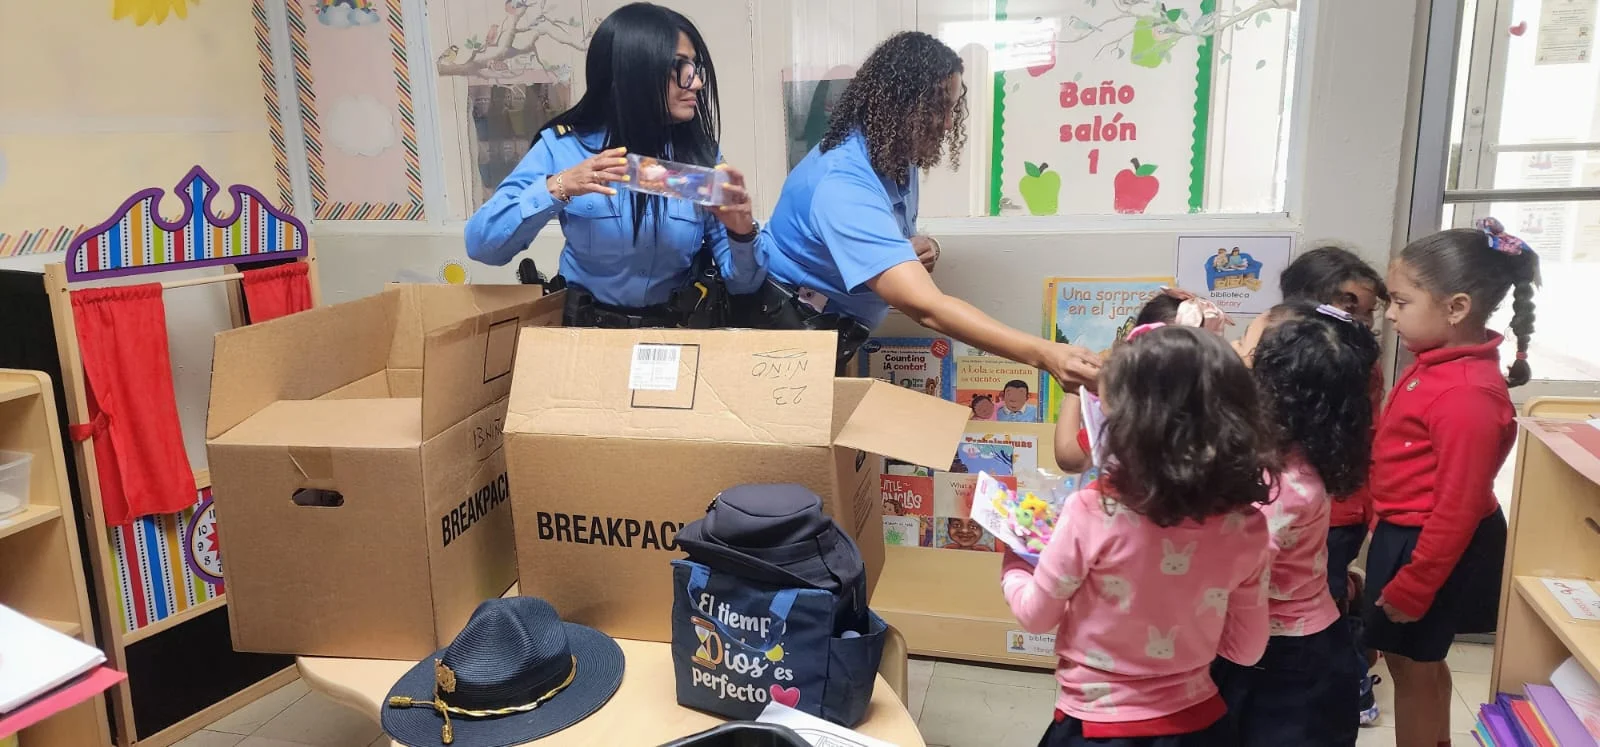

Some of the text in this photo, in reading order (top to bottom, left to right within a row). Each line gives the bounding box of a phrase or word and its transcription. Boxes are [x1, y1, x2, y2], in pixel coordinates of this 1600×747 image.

[1060, 80, 1135, 108] Baño
[1060, 112, 1137, 142] salón
[1088, 149, 1099, 174] 1
[1063, 287, 1156, 305] Una sorpres
[1216, 300, 1241, 308] library
[1068, 301, 1144, 320] en el jard
[883, 362, 927, 371] ¡A contar!
[885, 354, 926, 364] Counting
[968, 365, 987, 374] Lola
[773, 385, 808, 405] 23
[486, 417, 503, 440] NIÑ
[198, 525, 207, 536] 10
[537, 511, 690, 552] BREAKPAC
[197, 542, 204, 551] 9
[204, 556, 211, 566] 8
[699, 593, 786, 639] El tiemp
[774, 667, 794, 681] es
[691, 666, 767, 703] perfecto
